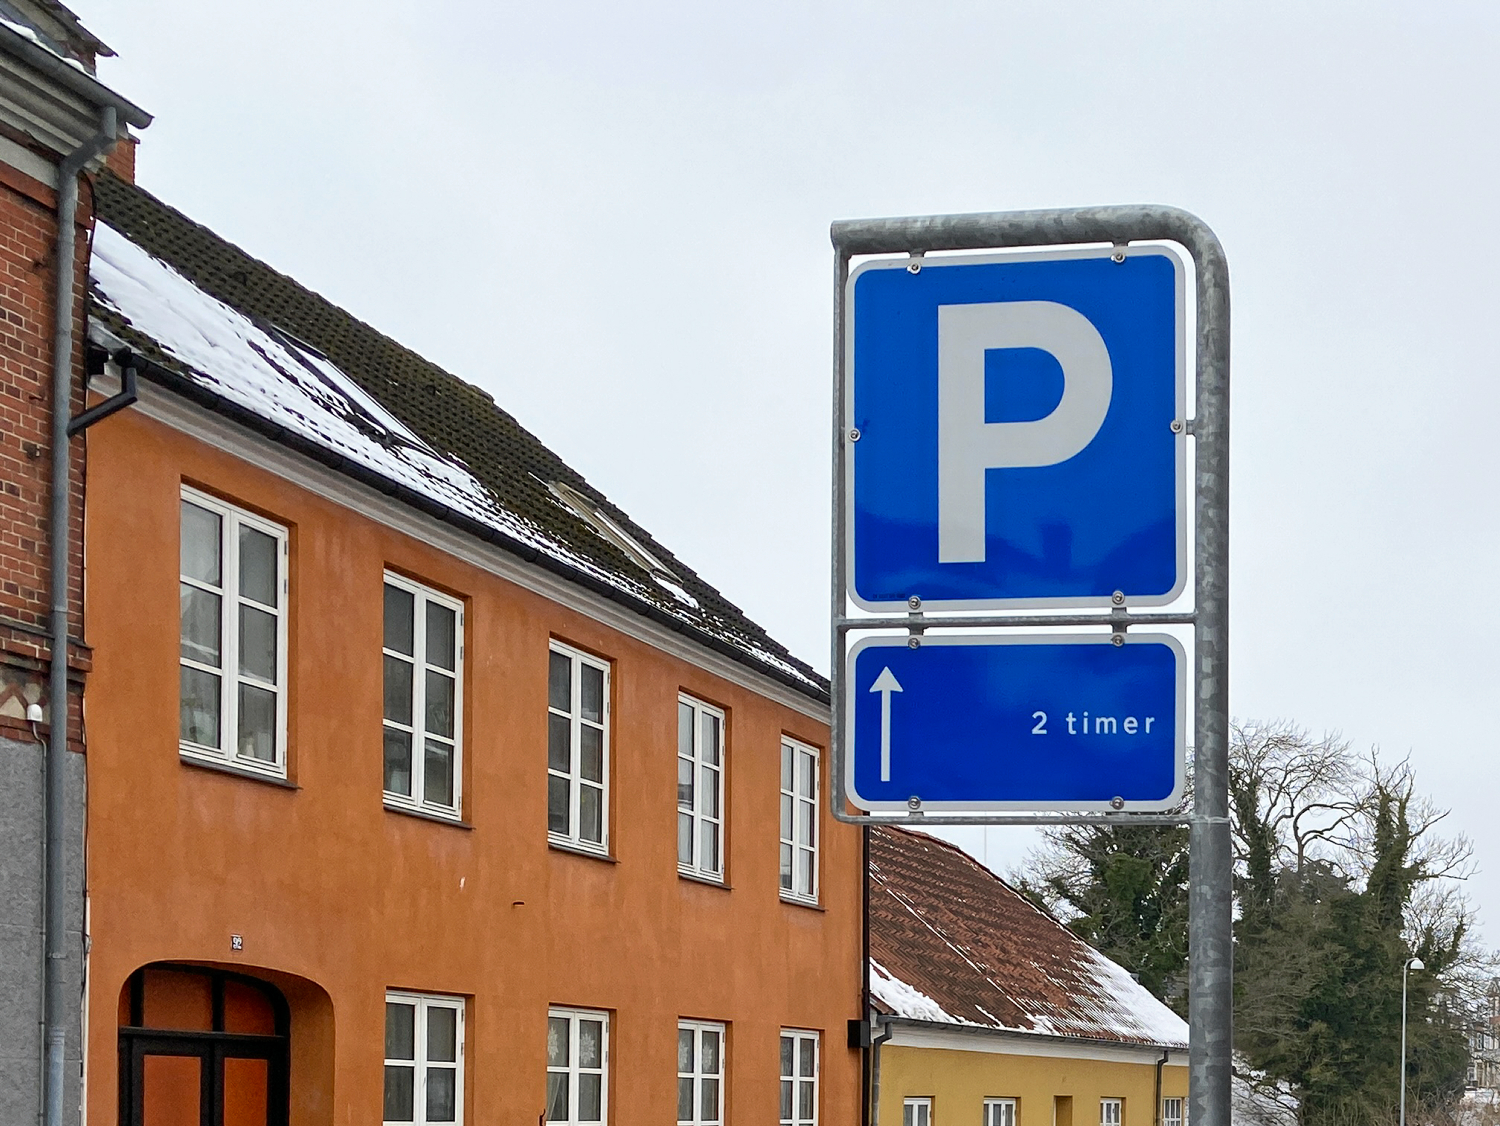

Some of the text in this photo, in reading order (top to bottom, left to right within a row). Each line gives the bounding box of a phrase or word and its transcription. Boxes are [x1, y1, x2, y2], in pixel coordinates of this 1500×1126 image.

[938, 300, 1113, 563] P
[1031, 711, 1156, 735] 2 timer
